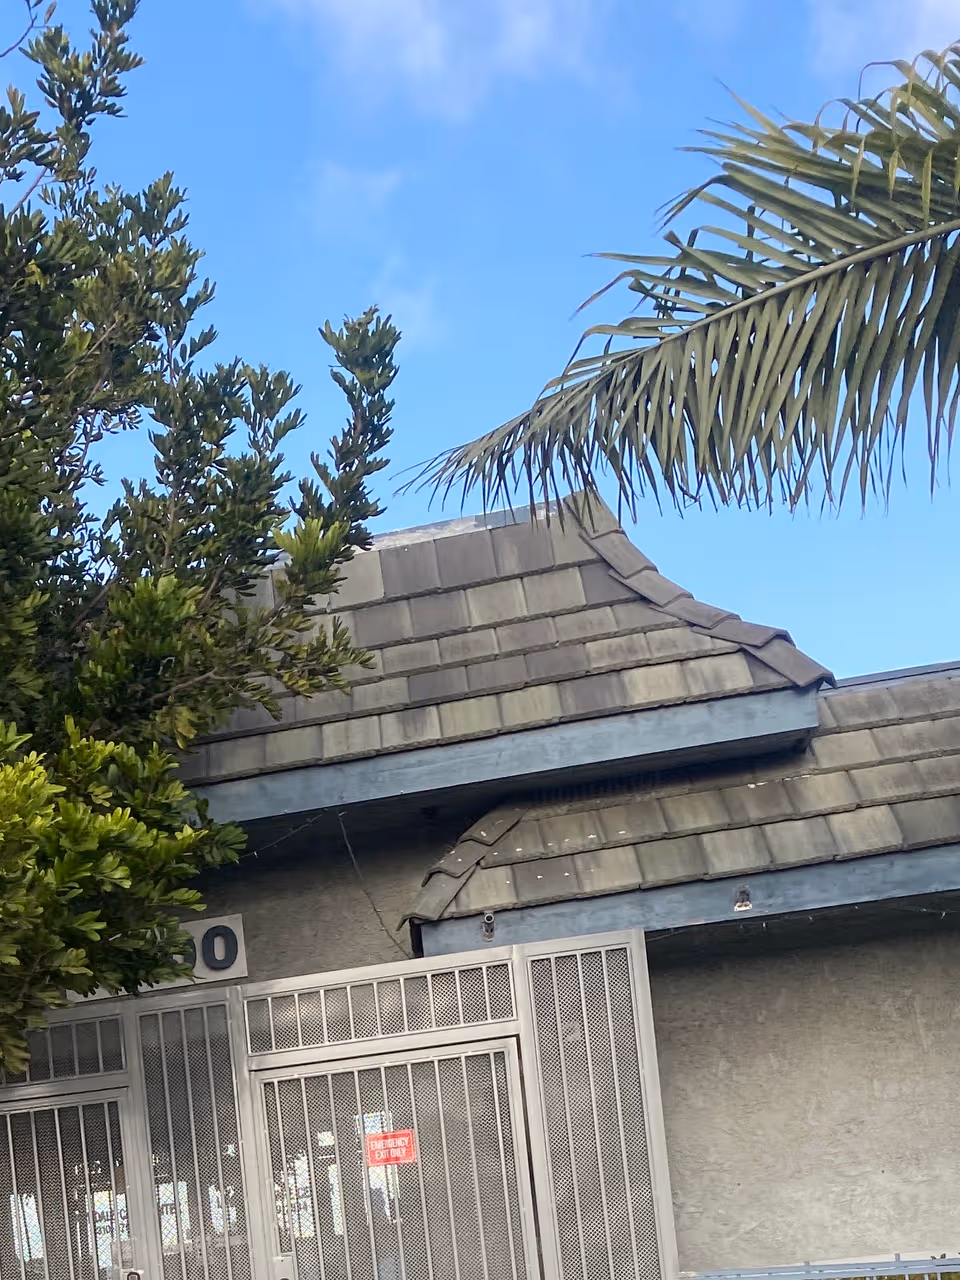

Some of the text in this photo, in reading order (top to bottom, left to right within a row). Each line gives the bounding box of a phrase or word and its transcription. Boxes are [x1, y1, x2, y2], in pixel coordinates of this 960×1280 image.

[184, 925, 238, 971] 0
[370, 1136, 409, 1150] EMERGENCY
[374, 1146, 407, 1160] EXIT ONLY
